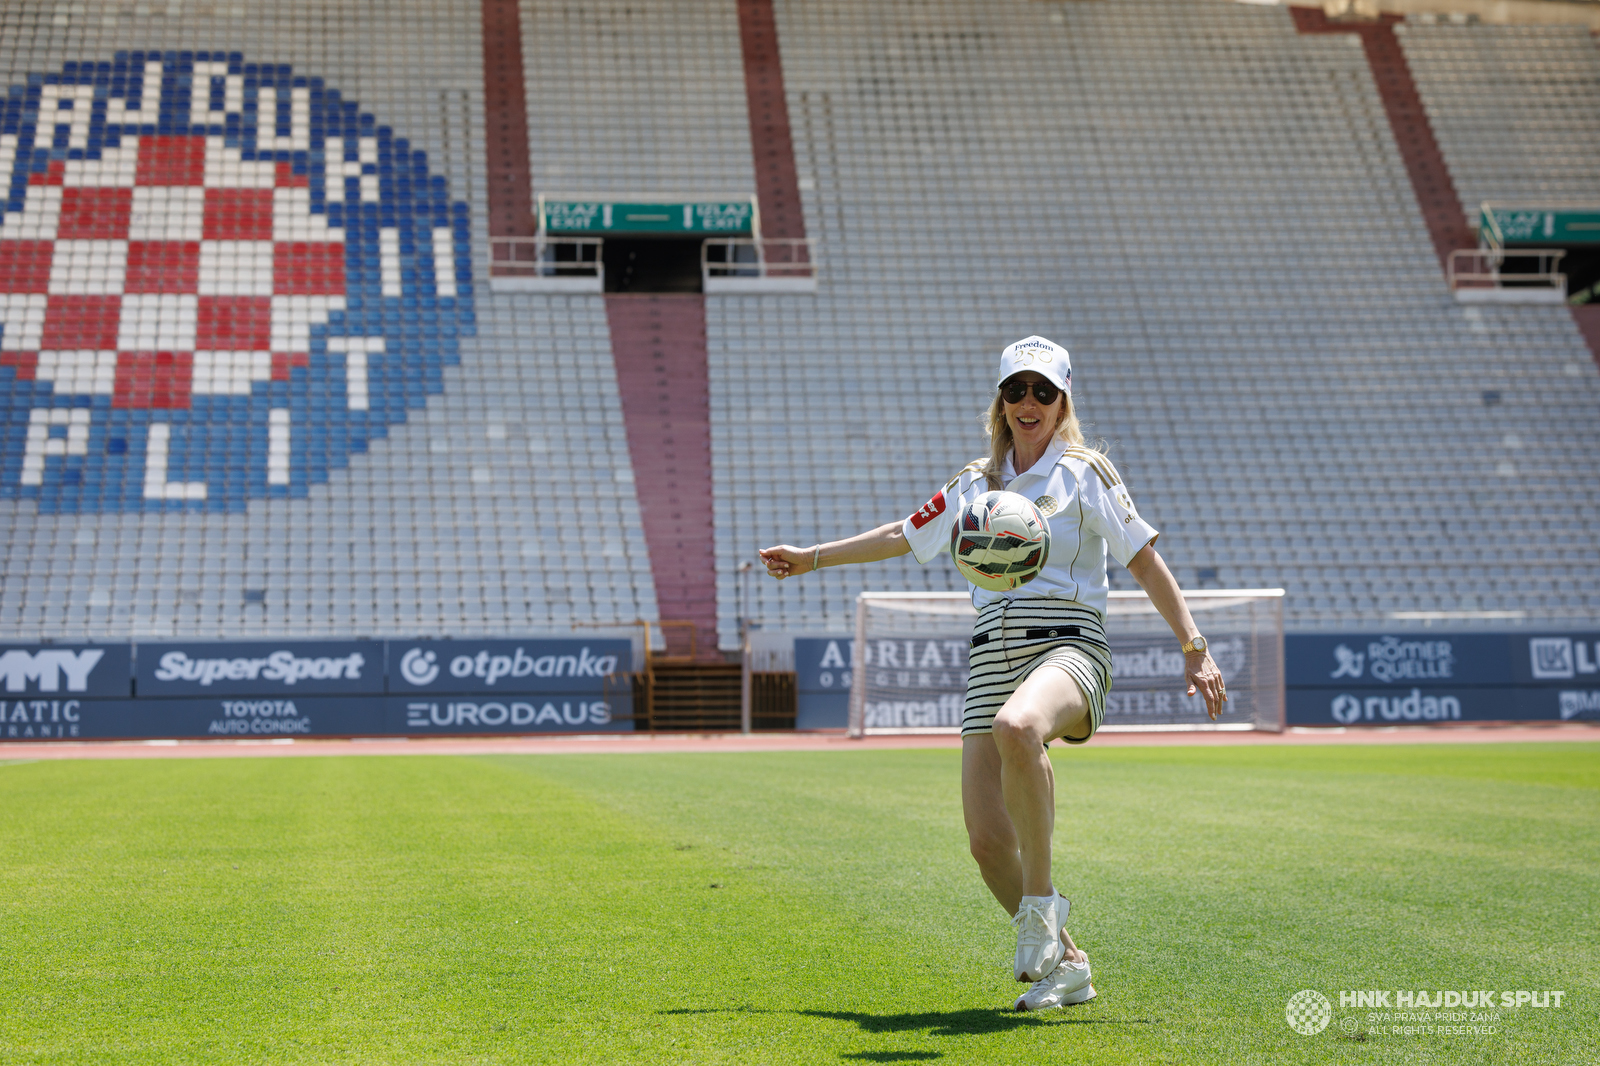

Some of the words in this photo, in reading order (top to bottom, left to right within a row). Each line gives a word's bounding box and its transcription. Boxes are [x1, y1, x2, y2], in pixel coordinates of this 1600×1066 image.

[1013, 348, 1053, 367] 250
[1014, 340, 1054, 352] Freedom
[154, 650, 364, 686] SuperSport
[450, 646, 618, 685] otpbanka
[1574, 641, 1600, 674] L
[1370, 659, 1453, 683] QUELLE
[221, 700, 298, 718] TOYOTA
[407, 702, 612, 726] EURODAUS
[1364, 688, 1461, 720] rudan
[0, 724, 80, 739] RANJE
[208, 719, 249, 735] AUTO
